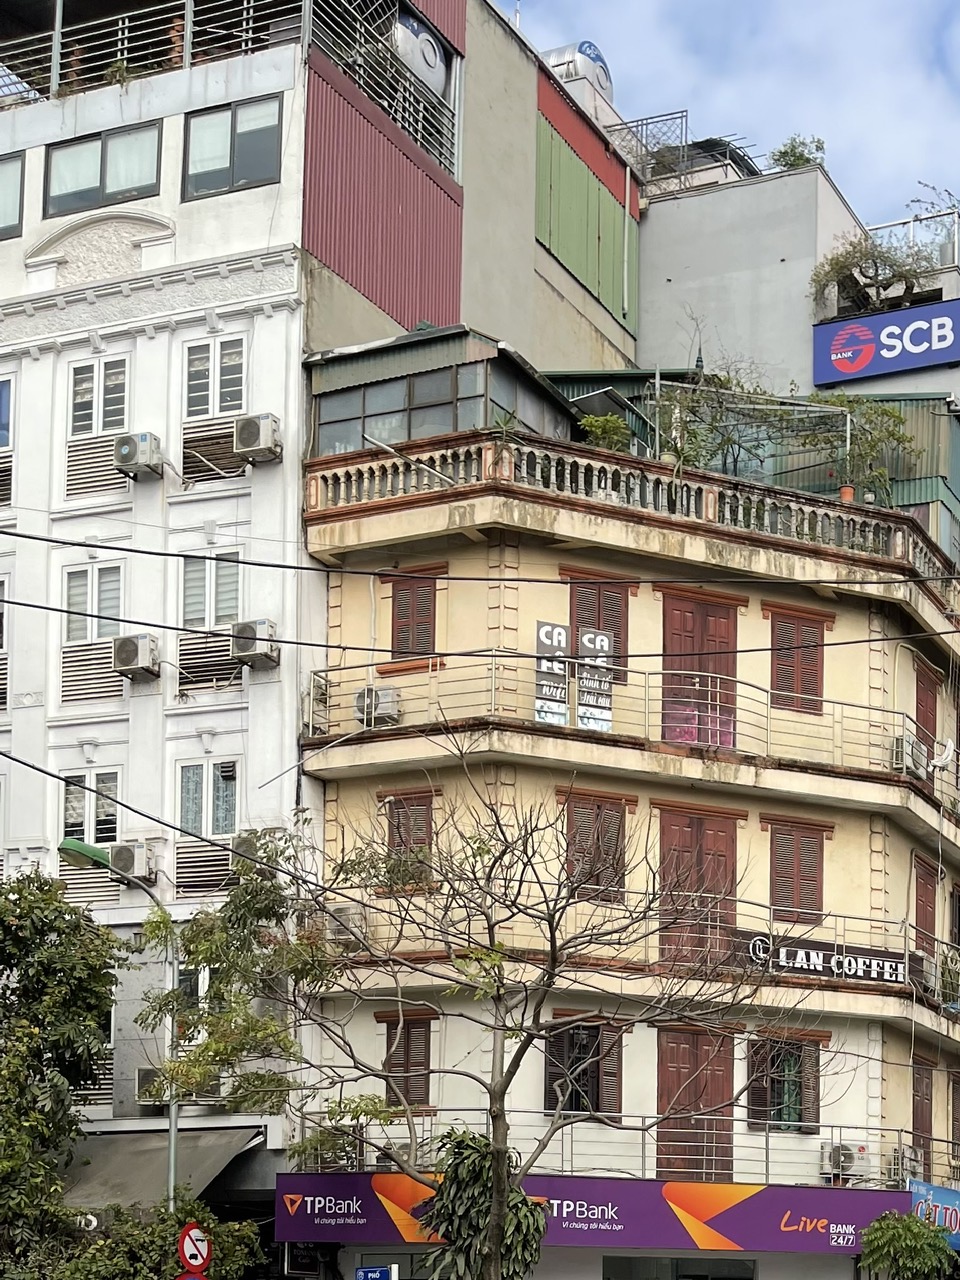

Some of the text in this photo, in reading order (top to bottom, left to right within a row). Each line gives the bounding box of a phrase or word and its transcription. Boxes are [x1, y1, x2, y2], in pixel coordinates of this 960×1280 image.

[879, 316, 955, 358] SCB
[831, 350, 853, 361] BANK
[539, 625, 567, 648] CA
[582, 633, 609, 651] CA
[779, 947, 823, 971] LAN
[304, 1196, 362, 1214] TPBank
[549, 1199, 619, 1220] TPBank
[780, 1210, 829, 1233] Live
[829, 1223, 856, 1234] BANK
[830, 1234, 855, 1245] 24/7
